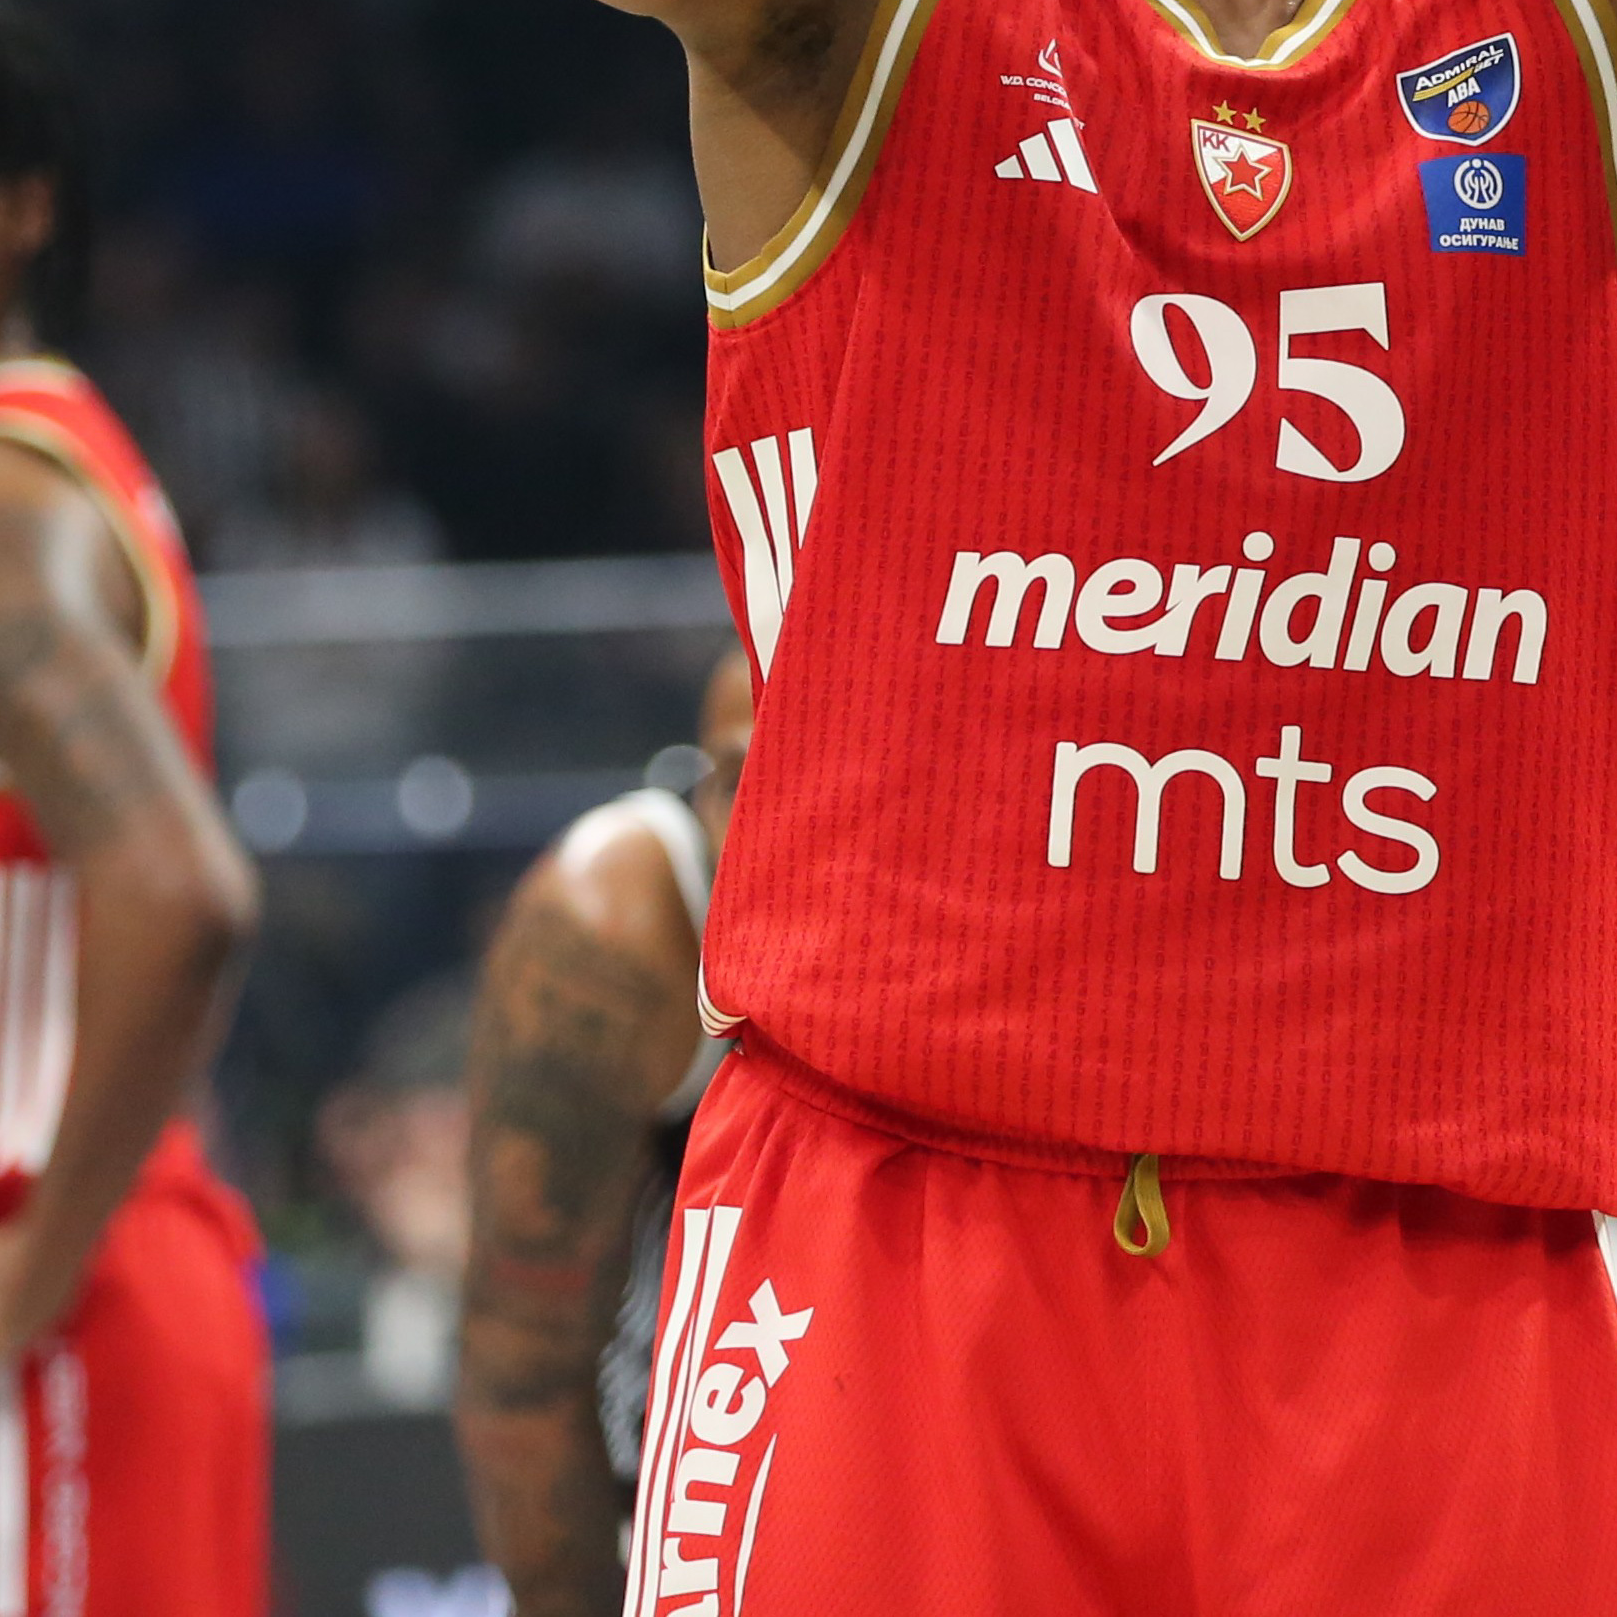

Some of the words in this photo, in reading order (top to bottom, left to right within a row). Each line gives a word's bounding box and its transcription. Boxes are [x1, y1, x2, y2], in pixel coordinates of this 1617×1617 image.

[1415, 45, 1504, 91] ADMIRAL
[1474, 53, 1504, 73] BET
[1000, 75, 1024, 86] W.D.
[1025, 77, 1068, 98] CONCO
[1447, 76, 1481, 108] ABA
[1033, 92, 1072, 110] BELGRA
[1202, 130, 1231, 153] KK
[1460, 217, 1505, 233] ДУНАВ
[1439, 234, 1519, 250] ОСИГУРАЊЕ
[1129, 281, 1406, 483] 95
[934, 530, 1549, 685] meridian
[1046, 724, 1441, 895] mts
